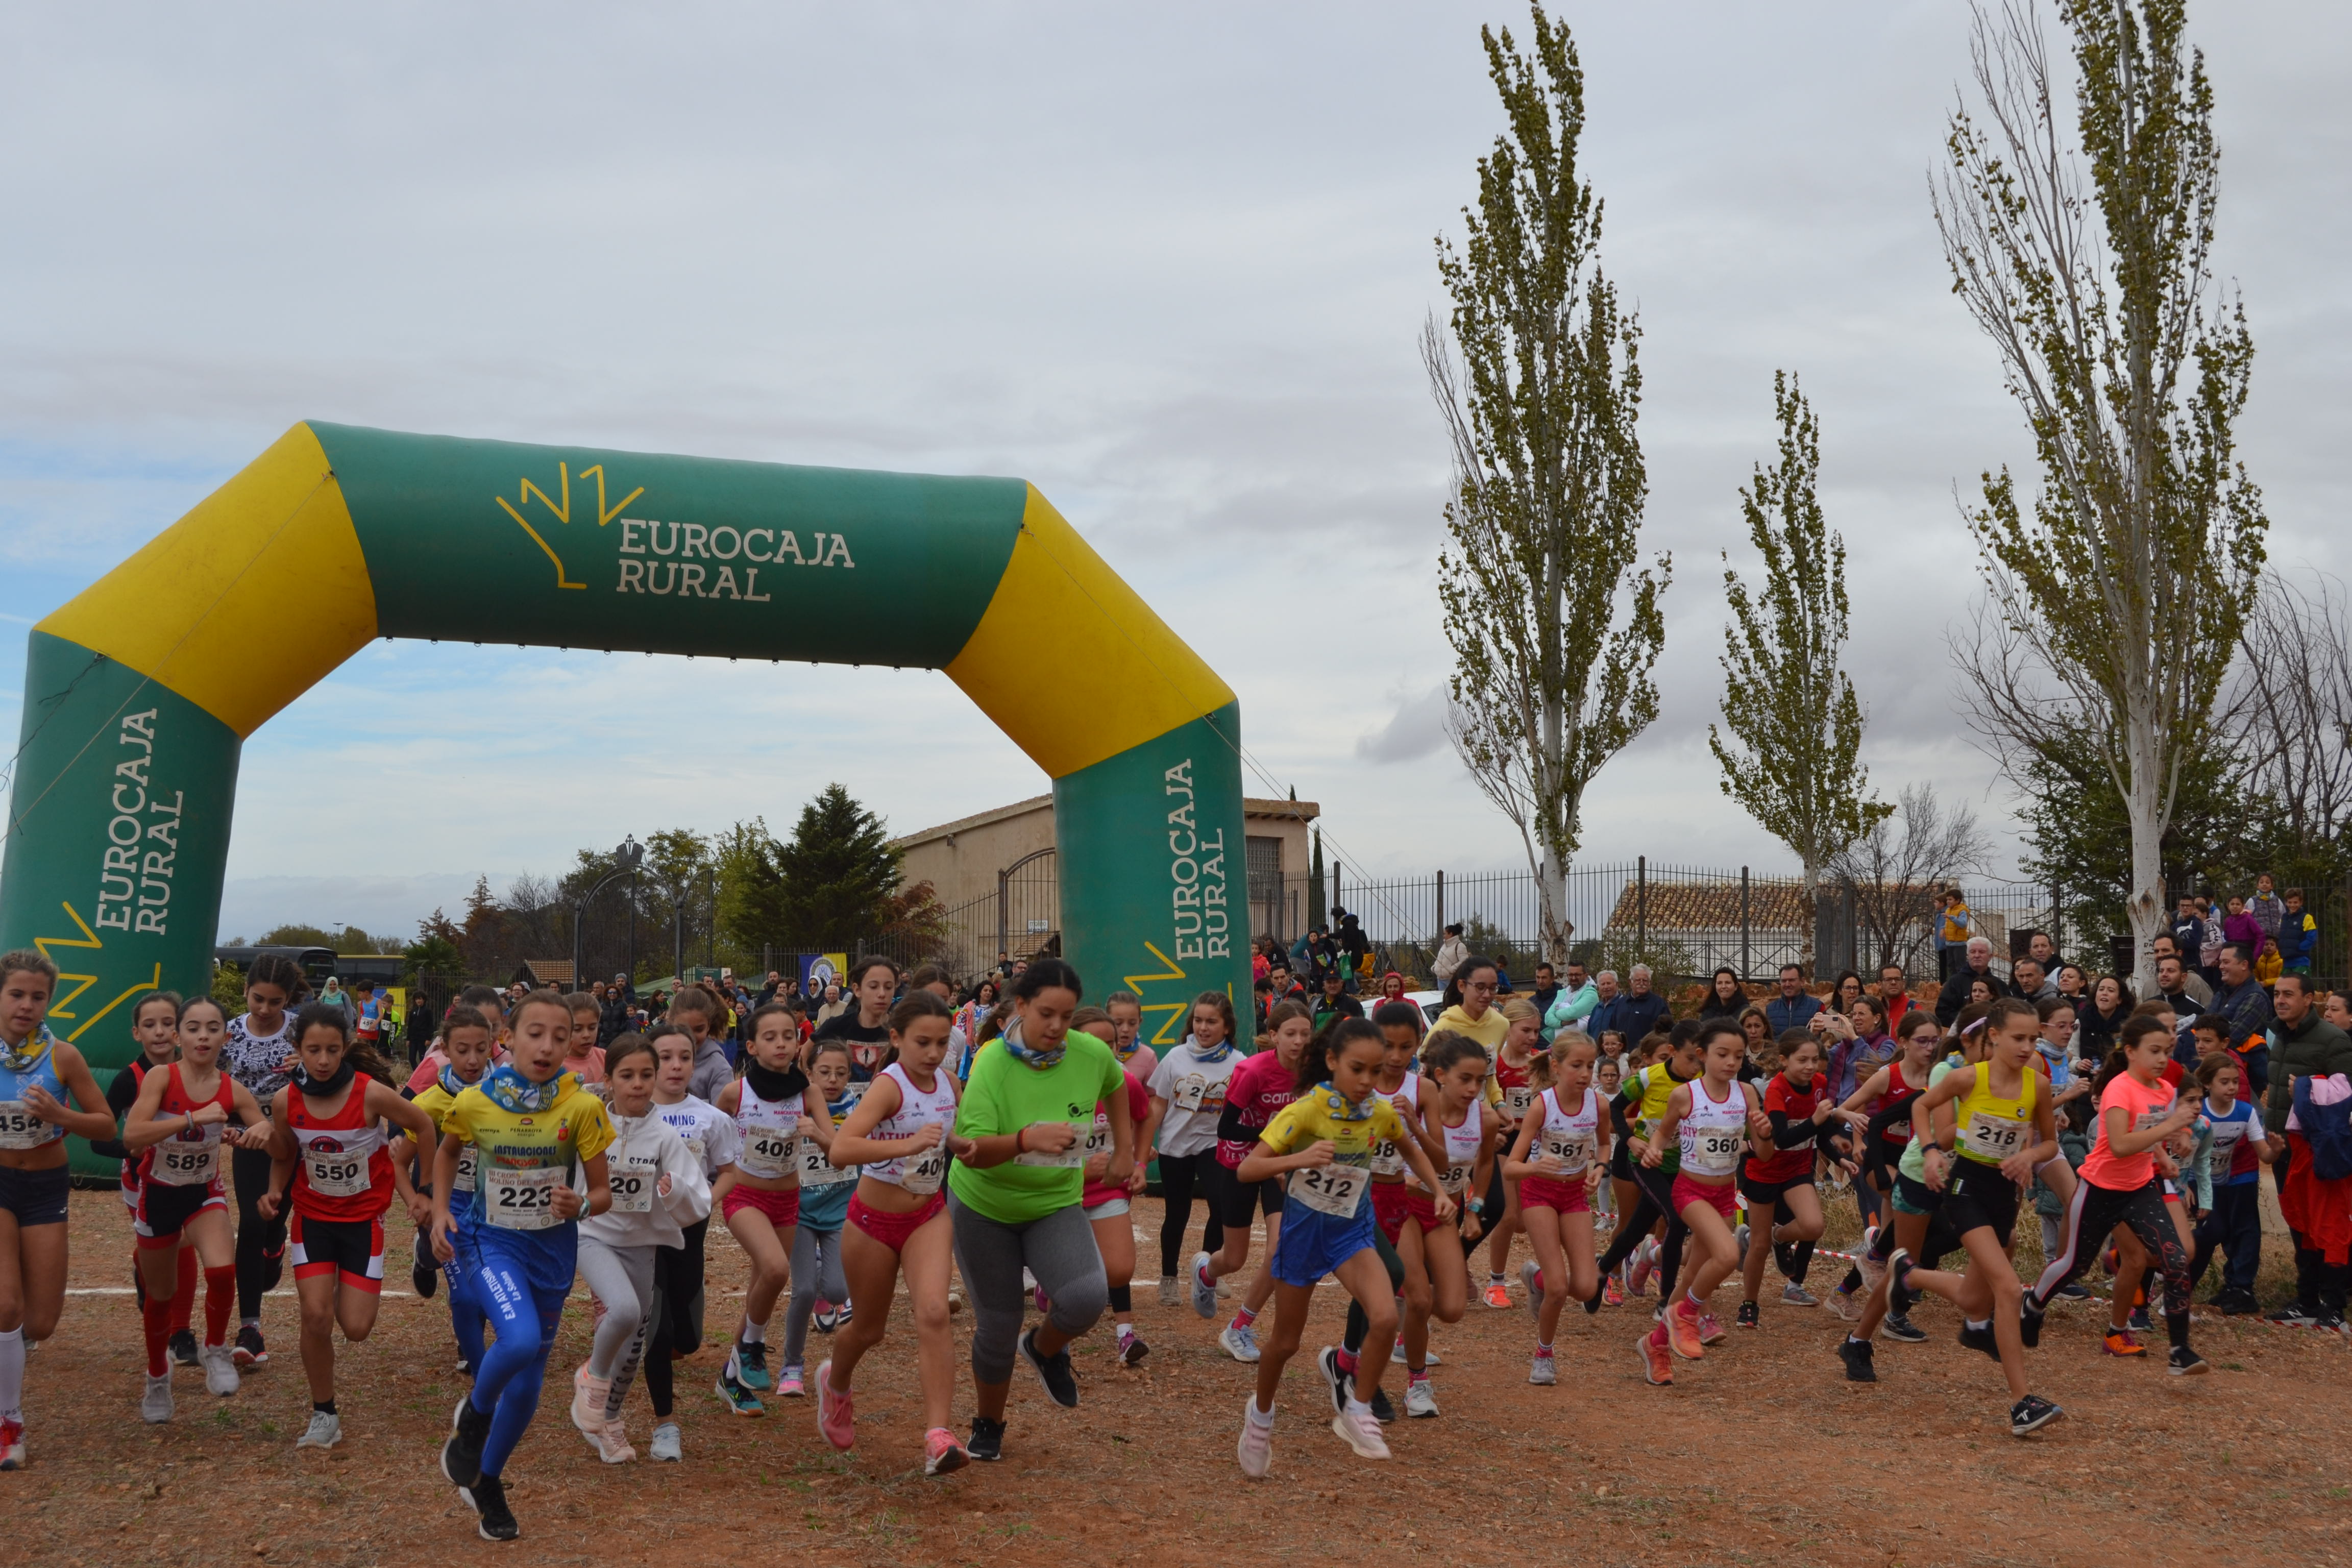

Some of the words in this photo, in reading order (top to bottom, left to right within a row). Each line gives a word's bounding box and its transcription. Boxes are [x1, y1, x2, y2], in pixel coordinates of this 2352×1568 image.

[619, 518, 855, 568] EUROCAJA
[616, 559, 771, 602] RURAL
[95, 708, 157, 931] EUROCAJA
[135, 791, 183, 935] RURAL
[1165, 758, 1204, 960] EUROCAJA
[1201, 828, 1230, 959] RURAL
[0, 1115, 43, 1132] 454
[1976, 1125, 2017, 1145] 218
[494, 1145, 556, 1156] INSTALACIONES
[754, 1139, 794, 1157] 408
[1550, 1142, 1584, 1157] 361
[1706, 1138, 1738, 1153] 360
[165, 1153, 210, 1170] 589
[315, 1163, 358, 1181] 550
[488, 1177, 515, 1186] MOLINO
[533, 1174, 564, 1186] REZUELO
[497, 1171, 521, 1180] CROSS
[1305, 1169, 1352, 1198] 212
[499, 1185, 553, 1208] 223
